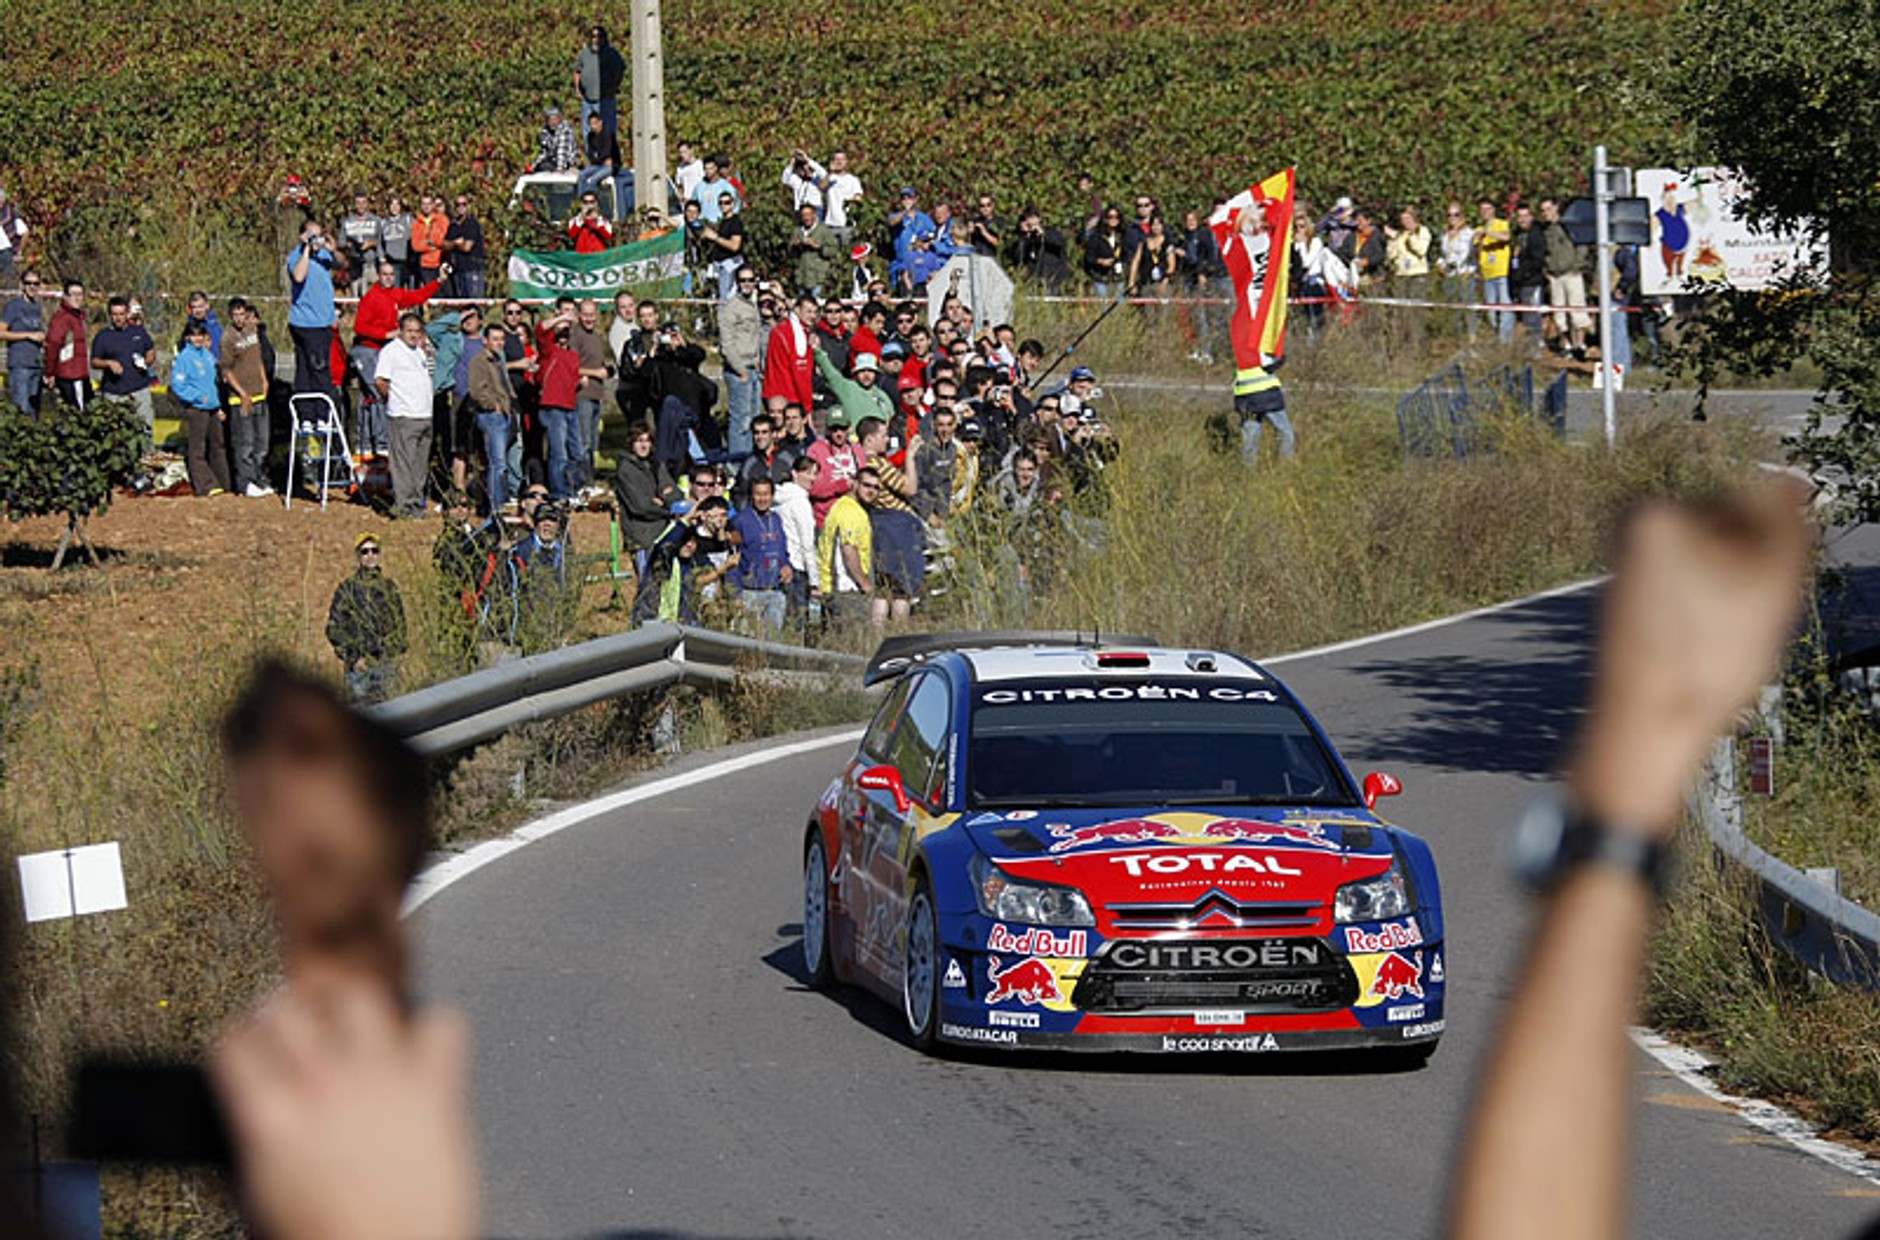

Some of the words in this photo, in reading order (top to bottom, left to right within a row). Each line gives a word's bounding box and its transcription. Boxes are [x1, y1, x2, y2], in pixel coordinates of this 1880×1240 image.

[1209, 688, 1278, 702] C4
[1109, 854, 1302, 876] TOTAL
[987, 923, 1035, 954] Red
[1032, 929, 1088, 957] Bull
[1345, 923, 1394, 952] Red
[1110, 940, 1318, 968] CITROËN
[1246, 978, 1322, 999] SPORT
